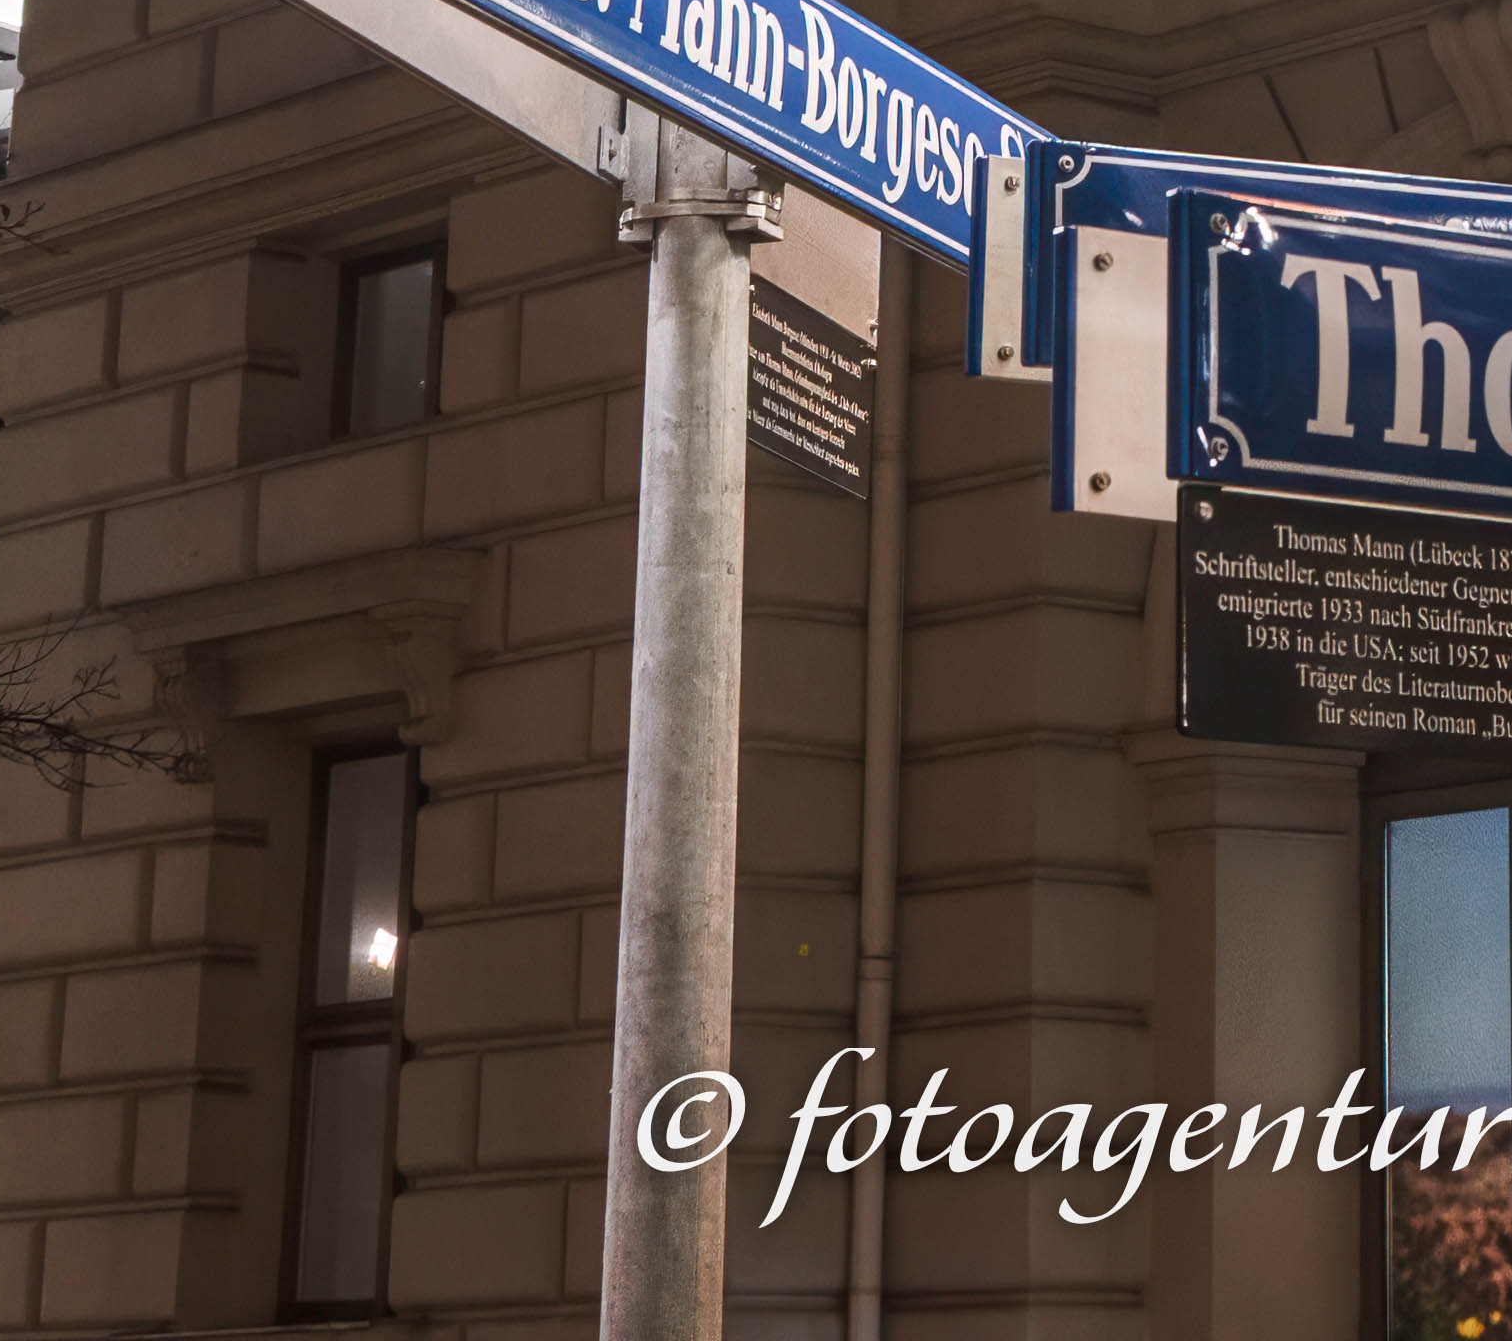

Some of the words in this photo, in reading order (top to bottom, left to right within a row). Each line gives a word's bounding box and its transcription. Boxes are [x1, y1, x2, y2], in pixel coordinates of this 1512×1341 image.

[1272, 523, 1348, 556] Thomas
[1352, 532, 1405, 562] Mann
[1408, 538, 1484, 570] (Lübeck
[1324, 567, 1449, 599] entschiedener
[1216, 588, 1314, 621] emigrierte
[1320, 596, 1364, 624] 1933
[1369, 604, 1412, 630] nach
[1246, 623, 1291, 652] 1938
[1296, 628, 1315, 654] in
[1318, 629, 1349, 657] die
[1409, 640, 1441, 665] seit
[1447, 642, 1491, 670] 1952
[1295, 662, 1358, 694] Träger
[1360, 668, 1393, 695] des
[1317, 698, 1346, 725] für
[1348, 702, 1407, 731] seinen
[1412, 706, 1477, 736] Roman
